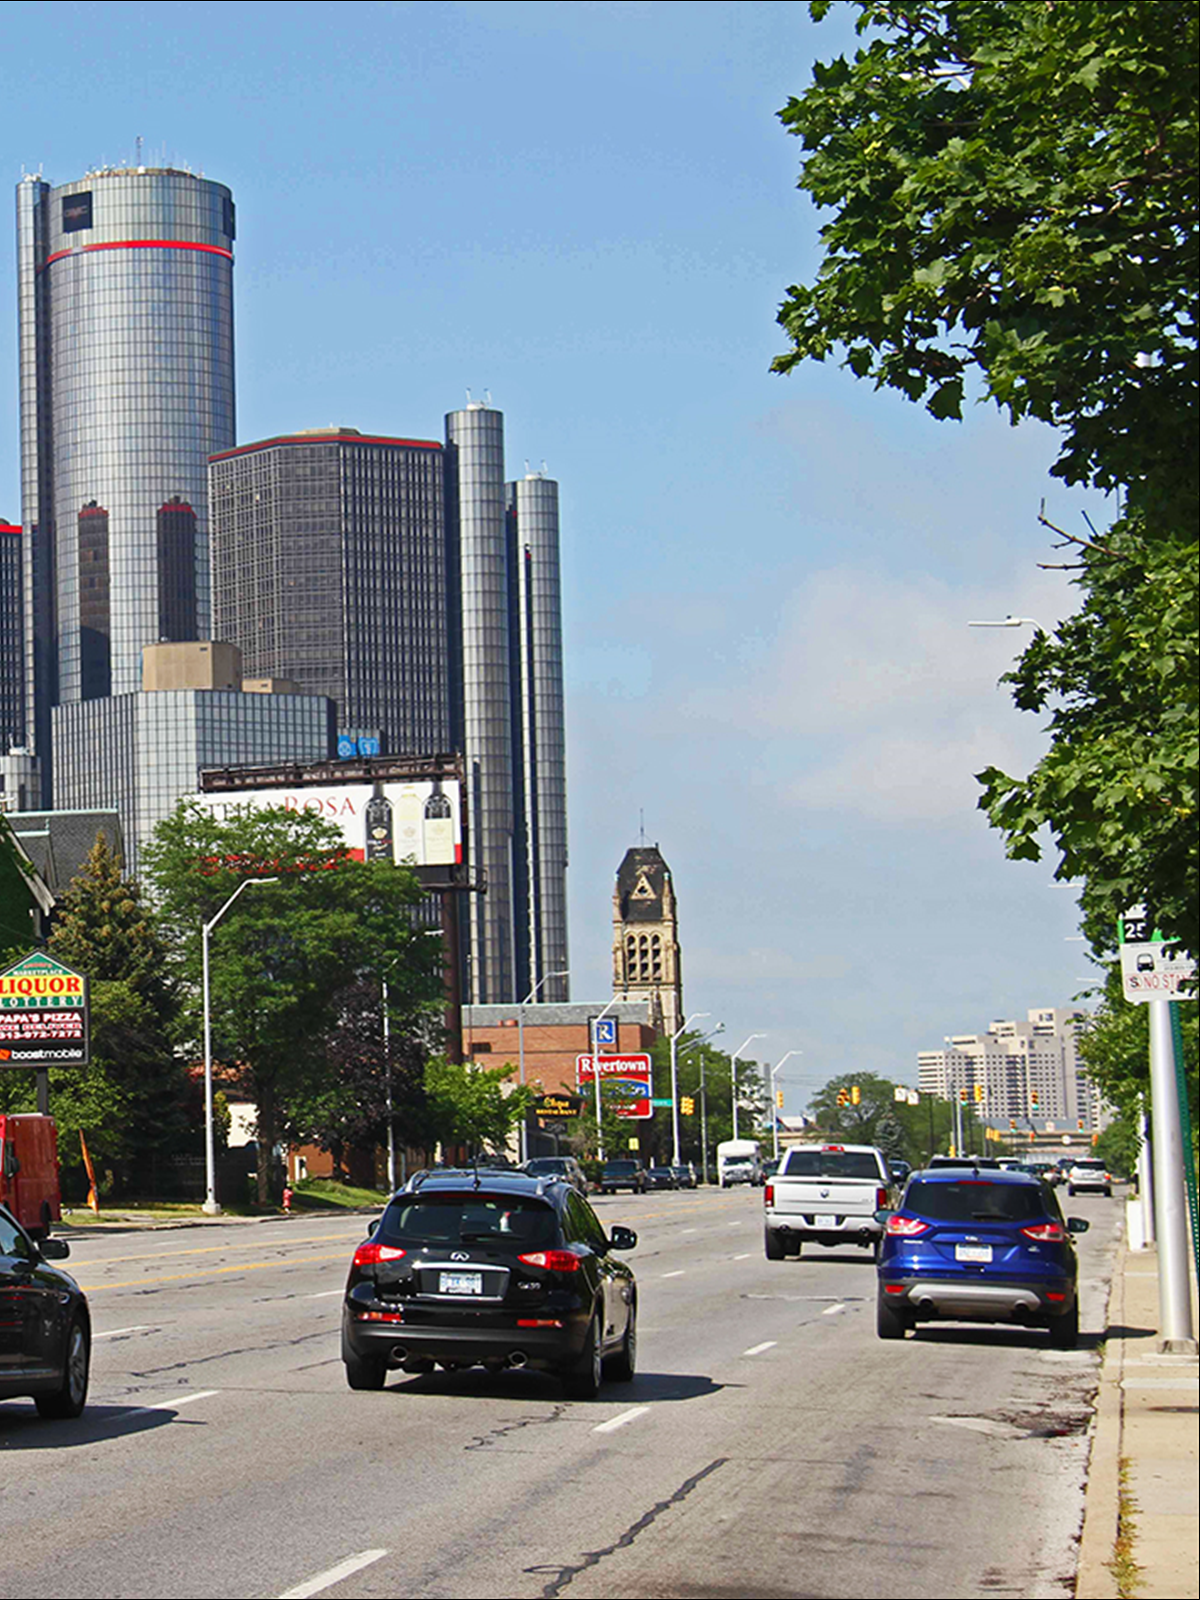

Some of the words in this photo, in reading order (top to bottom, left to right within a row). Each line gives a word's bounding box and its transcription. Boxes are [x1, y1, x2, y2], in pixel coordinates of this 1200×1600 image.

[284, 796, 356, 817] ROSA
[1124, 922, 1147, 939] 25
[43, 1012, 82, 1022] PIZZA
[599, 1024, 612, 1040] R
[581, 1058, 646, 1072] Rivertown
